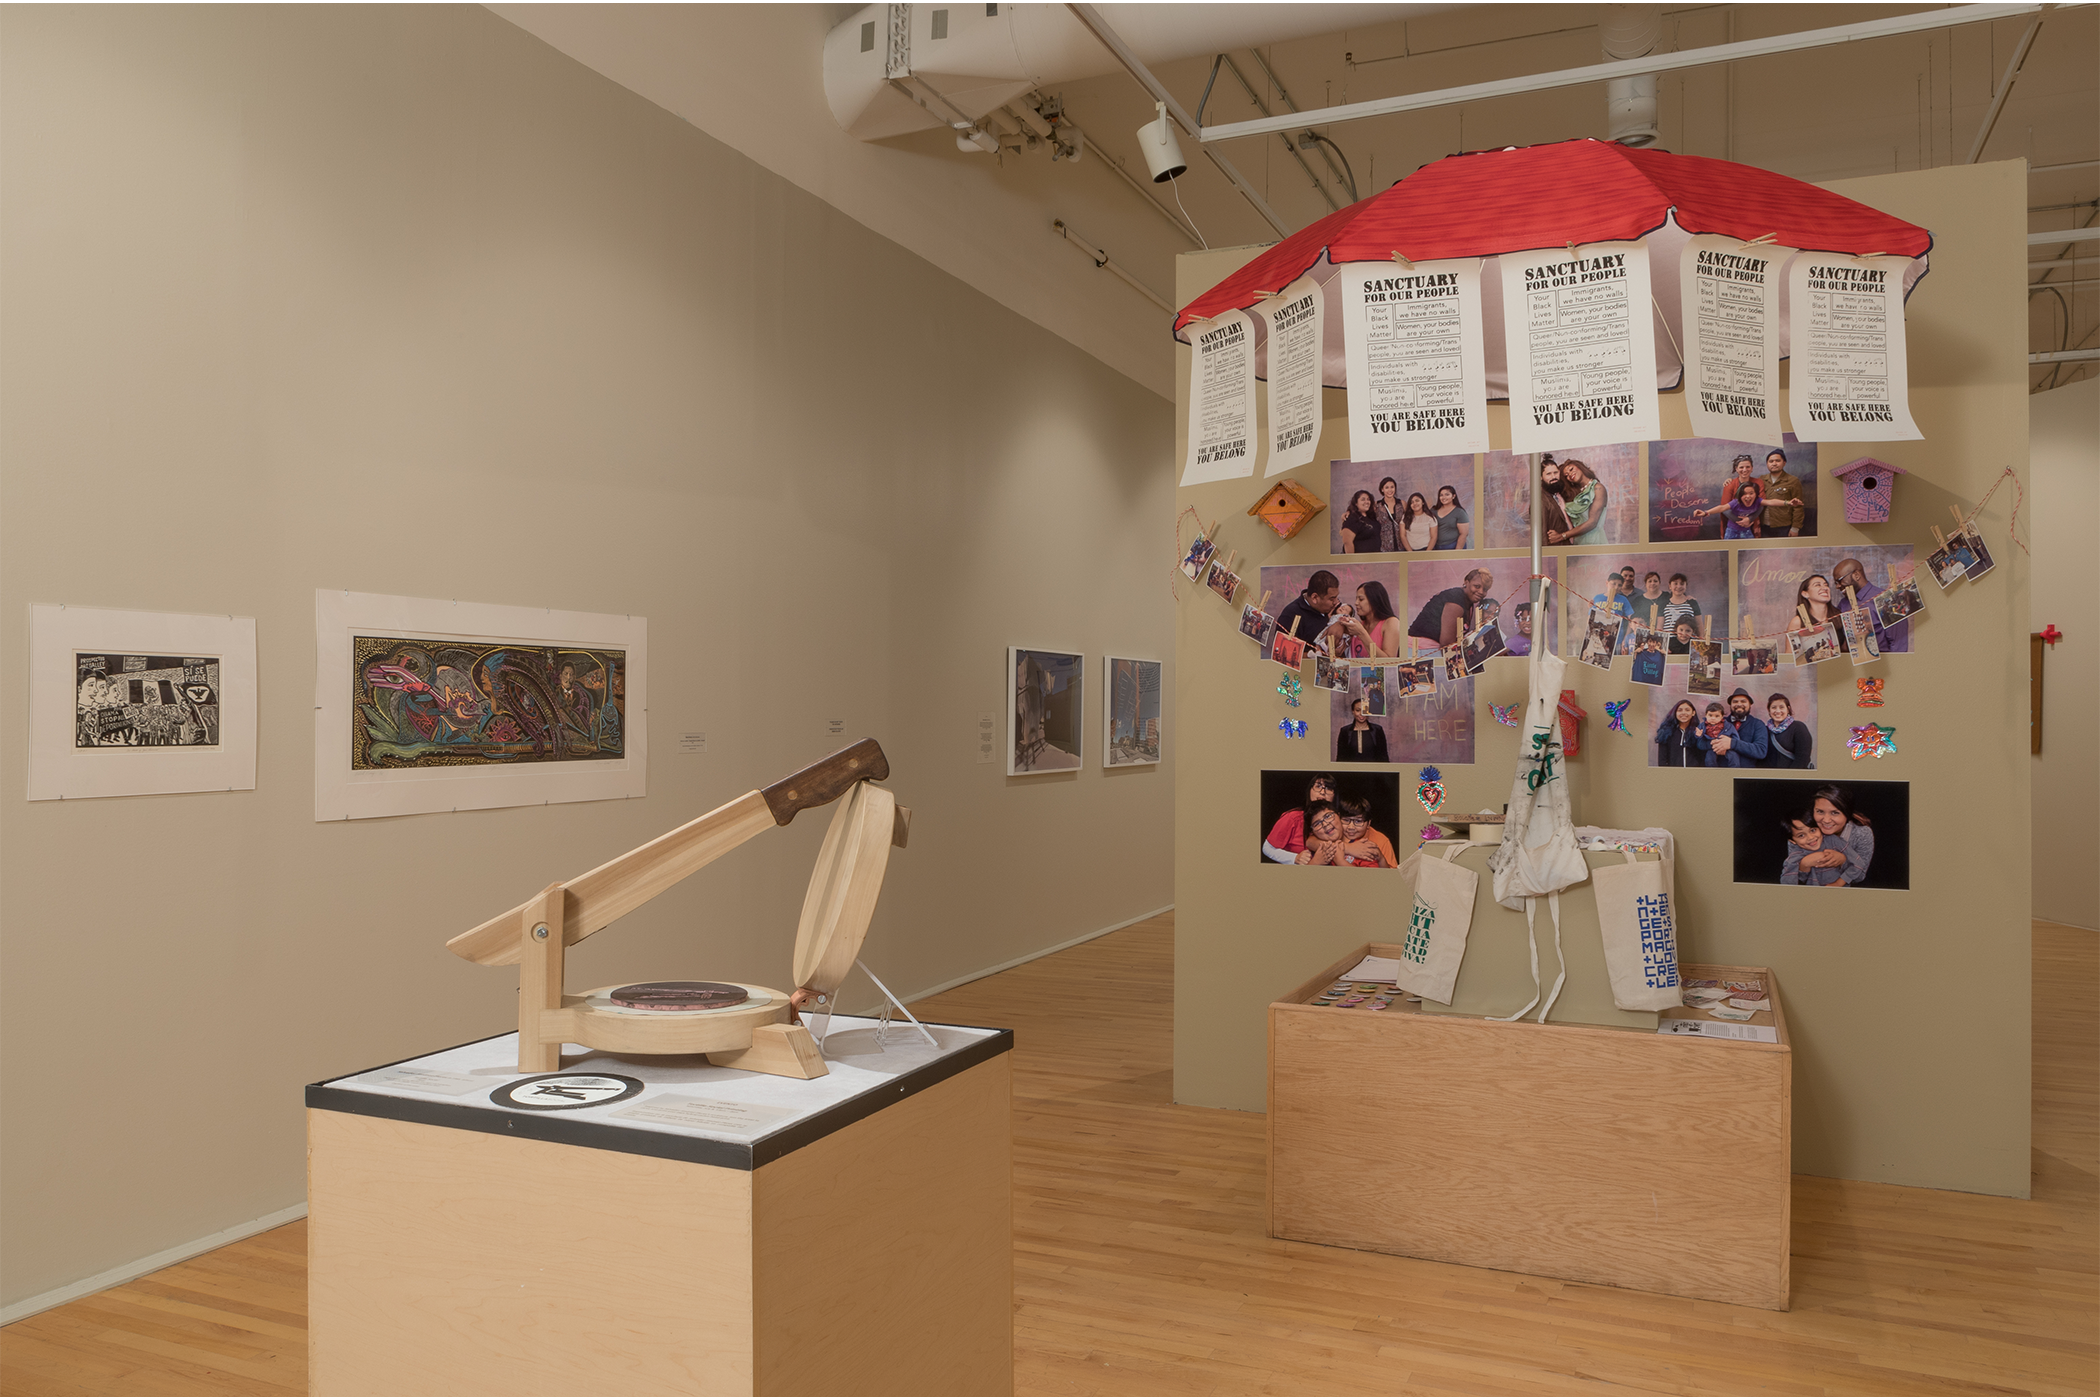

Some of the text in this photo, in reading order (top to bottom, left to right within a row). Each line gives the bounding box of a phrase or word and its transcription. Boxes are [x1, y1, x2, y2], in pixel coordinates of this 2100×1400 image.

[1525, 254, 1625, 281] SANCTUARY
[1698, 250, 1769, 273] SANCTUARY
[1526, 268, 1627, 291] FOR OUR PEOPLE
[1697, 265, 1765, 284] FOR OUR PEOPLE
[1809, 266, 1887, 283] SANCTUARY
[1364, 273, 1458, 293] SANCTUARY
[1808, 280, 1885, 293] FOR OUR PEOPLE
[1365, 286, 1459, 303] FOR OUR PEOPLE
[1572, 286, 1614, 296] Immigrants,
[1273, 294, 1314, 323] SANCTUARY
[1560, 309, 1587, 317] Women,
[1605, 303, 1627, 311] bodies
[1584, 315, 1600, 323] your
[1200, 321, 1243, 346] SANCTUARY
[1202, 333, 1245, 354] FOR OUR PEOPLE
[1605, 369, 1630, 377] people,
[1439, 383, 1462, 391] people,
[1593, 384, 1622, 394] powerful
[1427, 398, 1454, 406] powerful
[1535, 392, 1562, 400] honored
[1701, 392, 1765, 407] YOU ARE SAFE HERE
[1533, 395, 1634, 413] YOU ARE SAFE HERE
[1702, 401, 1766, 419] YOU BELONG
[1808, 402, 1824, 410] YOU
[1827, 403, 1844, 411] ARE
[1370, 408, 1465, 421] YOU ARE SAFE HERE
[1534, 404, 1634, 425] YOU BELONG
[1809, 411, 1894, 422] YOU BELONG
[1371, 417, 1465, 433] YOU BELONG
[1197, 447, 1246, 465] YOU BELONG
[1665, 486, 1695, 499] People
[1664, 511, 1703, 526] Freedom!
[1742, 557, 1807, 587] Amor
[1414, 720, 1467, 741] HERE
[1413, 904, 1435, 918] IZA
[1407, 925, 1431, 940] CIA
